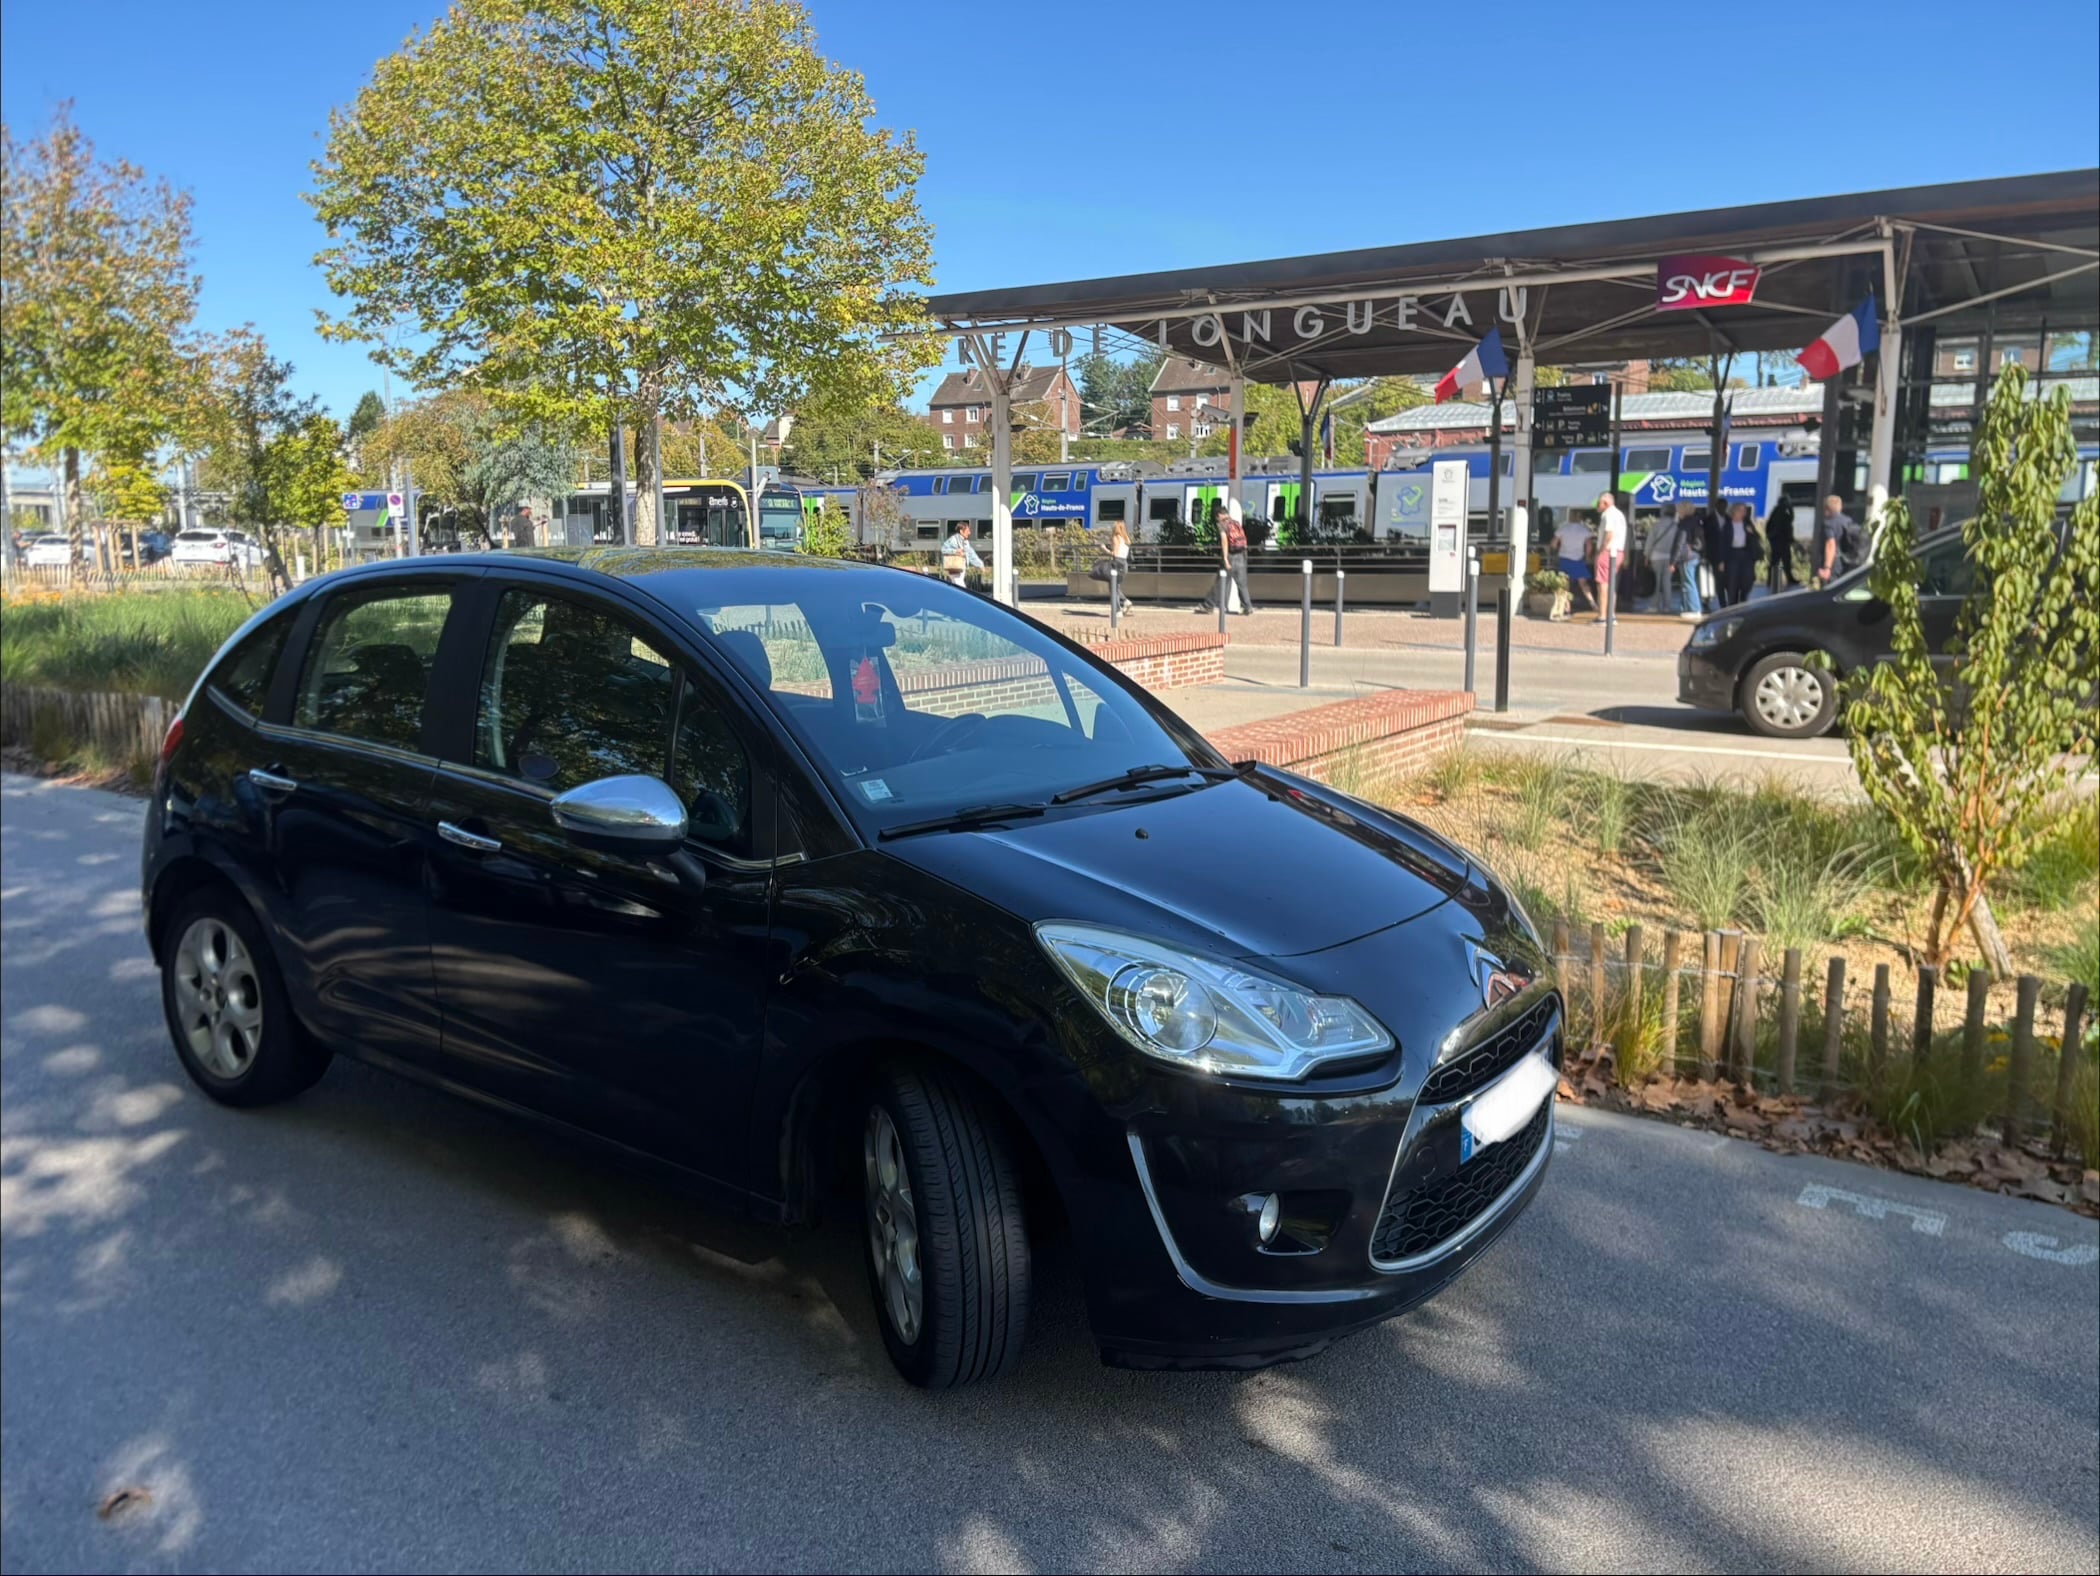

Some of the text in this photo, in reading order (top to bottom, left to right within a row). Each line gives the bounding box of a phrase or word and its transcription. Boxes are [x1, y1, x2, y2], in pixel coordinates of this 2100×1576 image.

[1662, 269, 1755, 302] SNCF
[958, 286, 1527, 365] RE DE LONGUEAU
